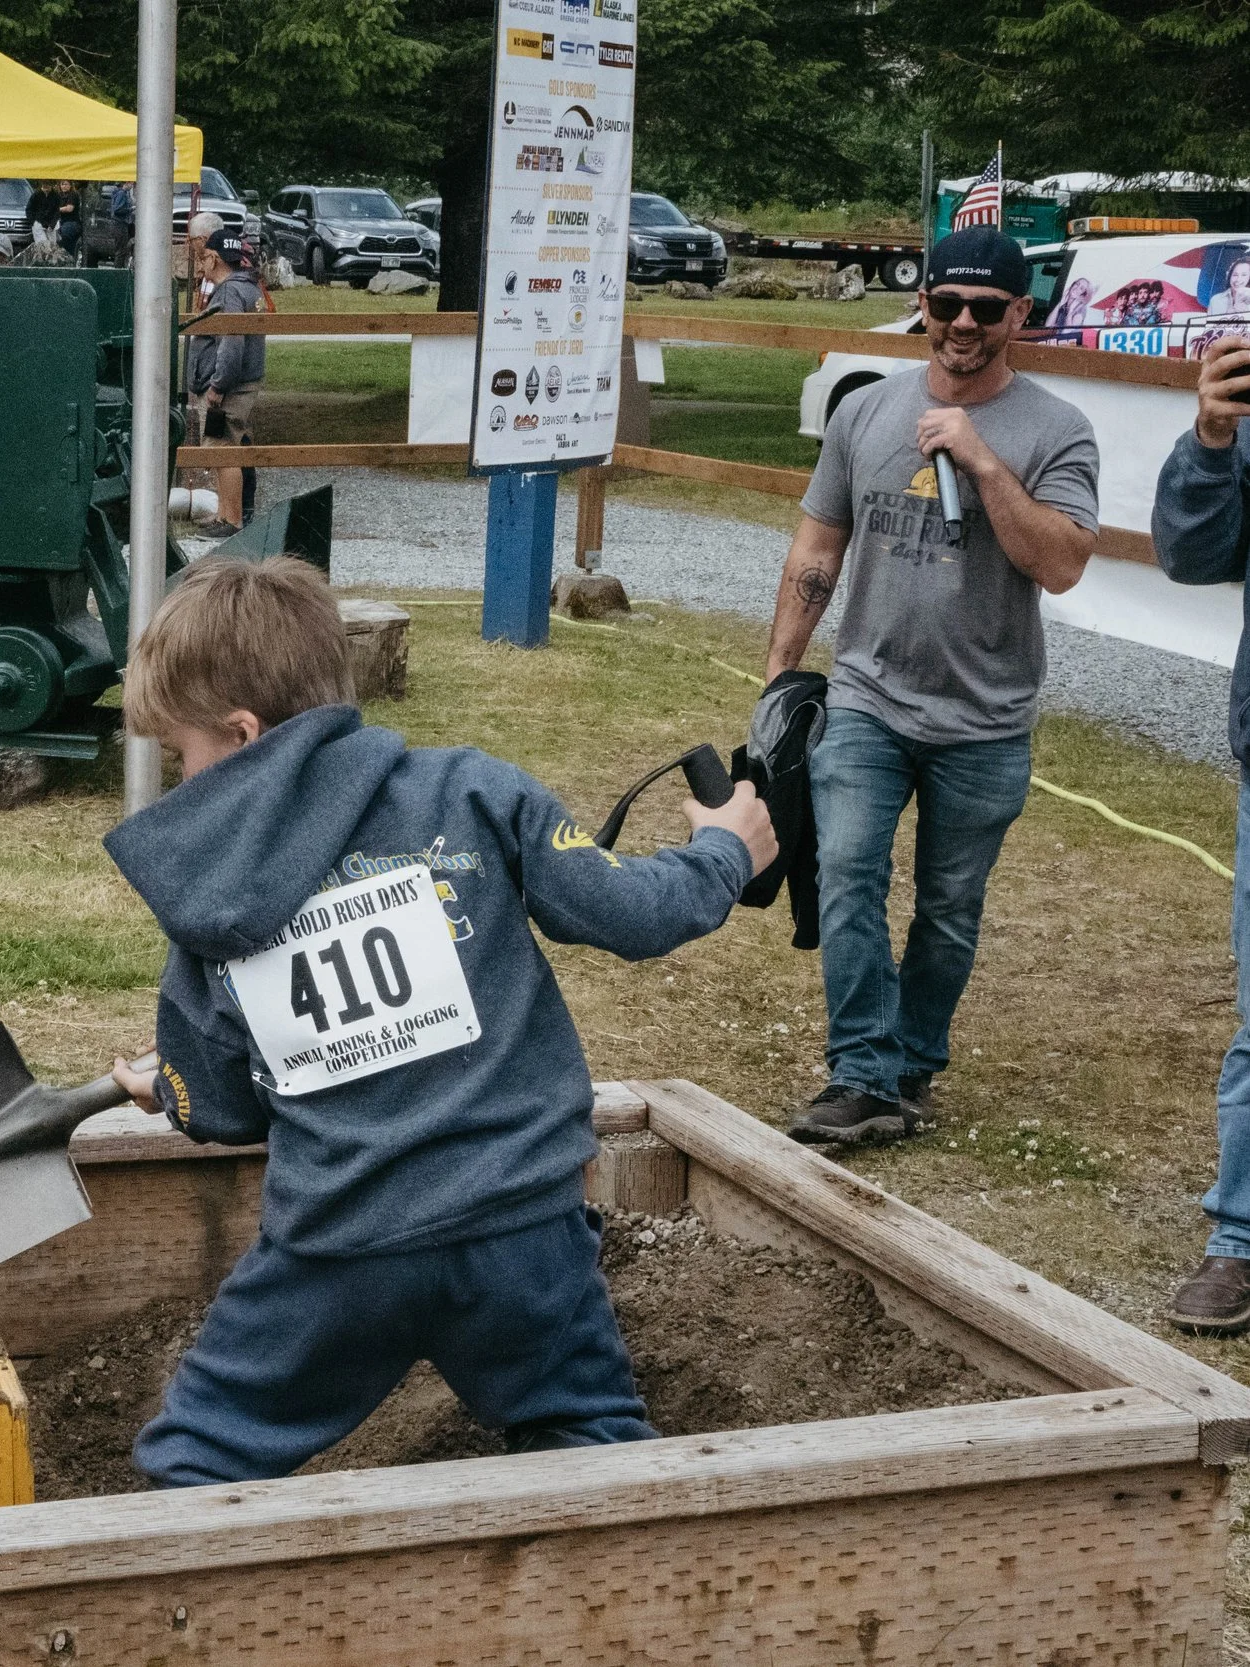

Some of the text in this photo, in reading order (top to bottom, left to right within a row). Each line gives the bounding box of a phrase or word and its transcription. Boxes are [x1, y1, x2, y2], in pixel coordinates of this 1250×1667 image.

[548, 79, 597, 99] GOLD SPONSORS
[554, 126, 594, 141] JENNMAR
[604, 119, 631, 133] SANDVIK
[563, 185, 593, 201] SPONSORS
[511, 209, 535, 227] Alaska
[556, 211, 589, 226] LYNDEN
[538, 246, 590, 263] COPPER SPONSORS
[528, 278, 562, 289] TEMSCO
[534, 341, 558, 356] FRIENDS
[867, 509, 914, 539] GOLD
[288, 908, 332, 940] GOLD
[333, 892, 376, 926] RUSH
[376, 878, 419, 912] DAYS
[291, 926, 413, 1034] 410
[283, 1003, 460, 1071] ANNUAL MINING & LOGGING
[325, 1031, 418, 1074] COMPETITION
